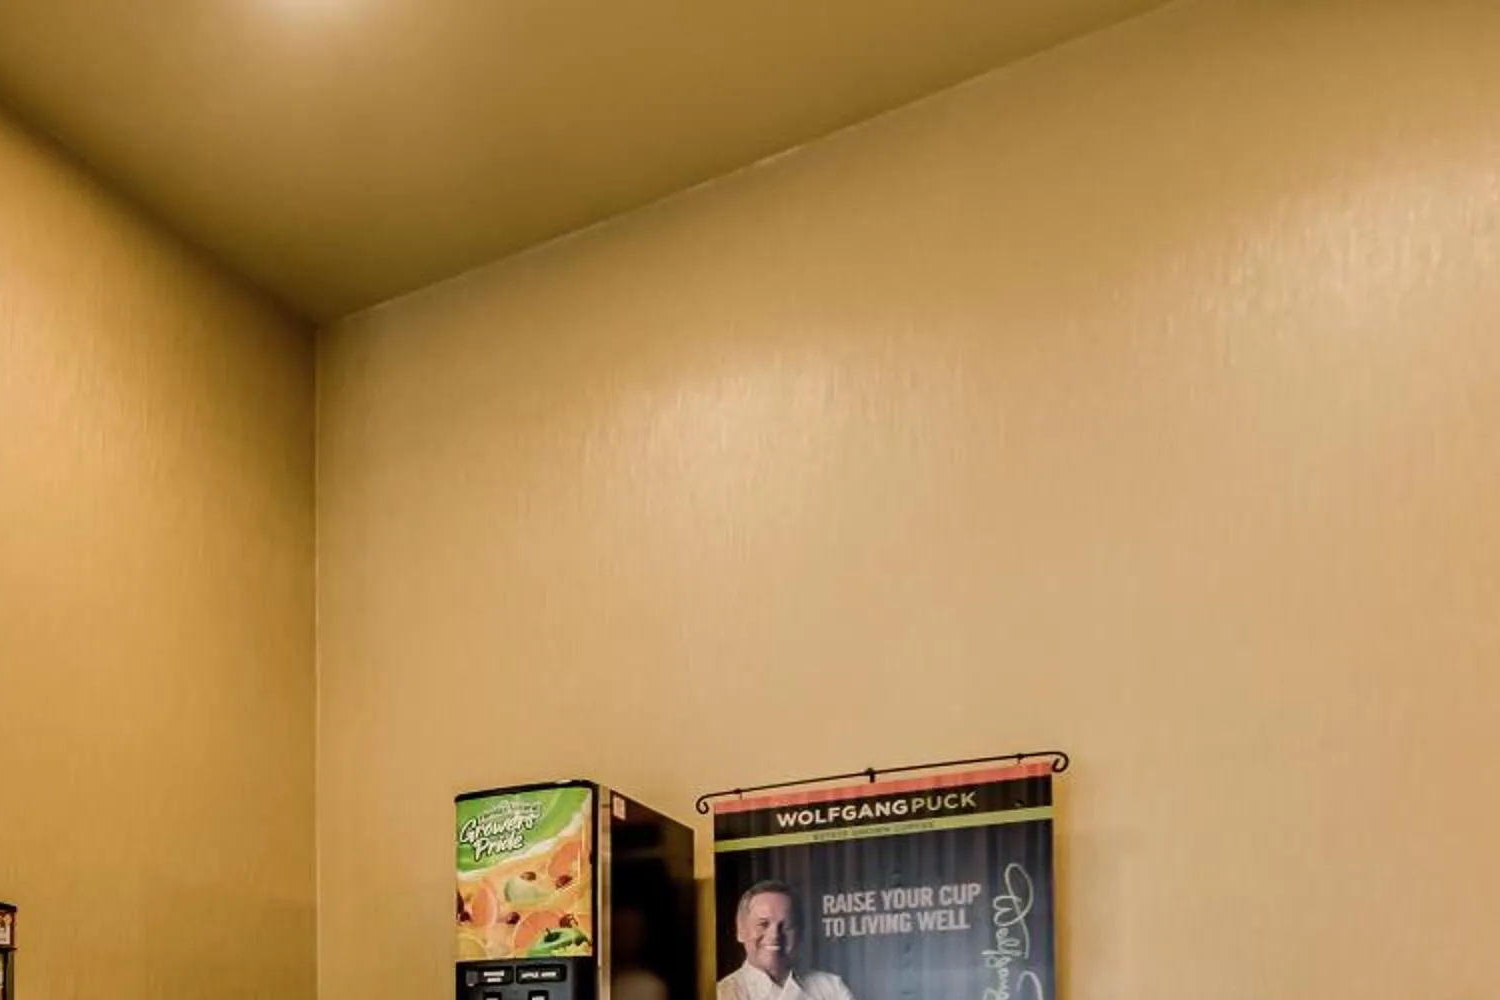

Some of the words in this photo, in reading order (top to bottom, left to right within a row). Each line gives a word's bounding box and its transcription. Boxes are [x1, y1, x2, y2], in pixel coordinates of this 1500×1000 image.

[474, 832, 524, 861] Pride
[822, 891, 877, 915] RAISE
[881, 886, 934, 911] YOUR
[939, 882, 982, 906] CUP
[822, 917, 845, 937] TO
[850, 912, 912, 937] LIVING
[917, 908, 972, 931] WELL
